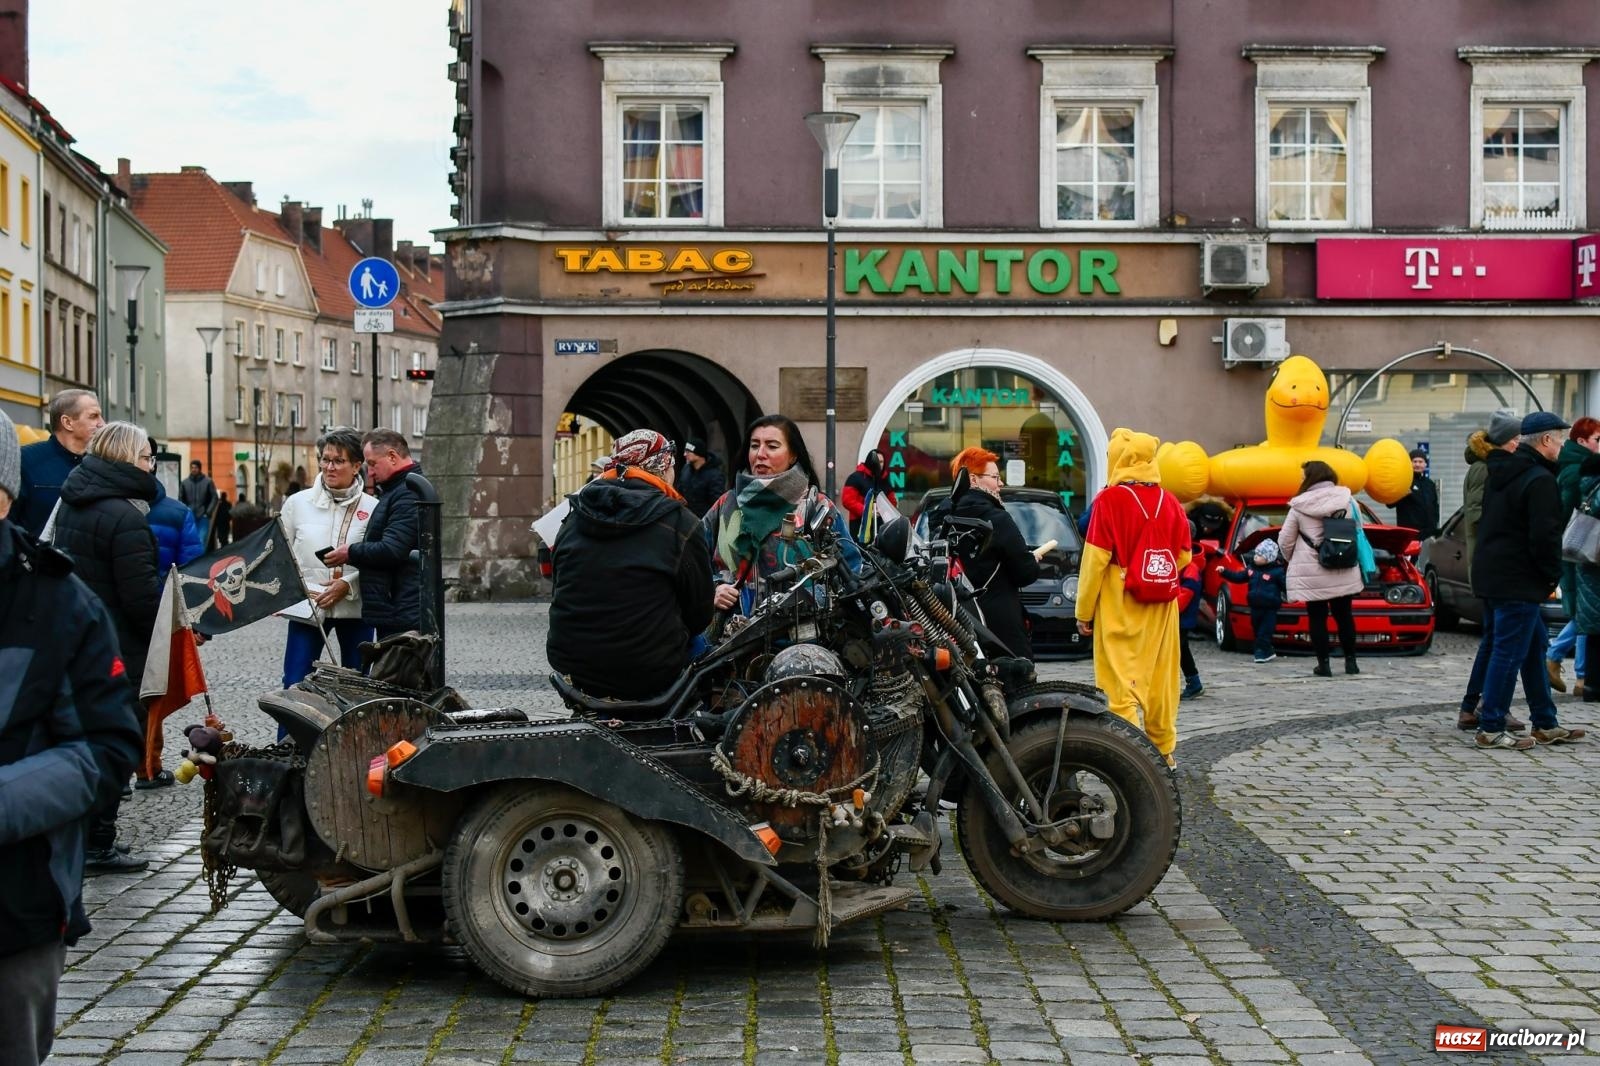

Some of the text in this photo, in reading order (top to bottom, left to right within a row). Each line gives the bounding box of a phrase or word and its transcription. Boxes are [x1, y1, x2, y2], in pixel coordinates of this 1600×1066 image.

[556, 248, 753, 273] TABAC
[844, 249, 1120, 293] KANTOR
[663, 278, 755, 296] pod arkadami
[558, 342, 597, 352] RYNEK
[932, 387, 1030, 406] KANTOR
